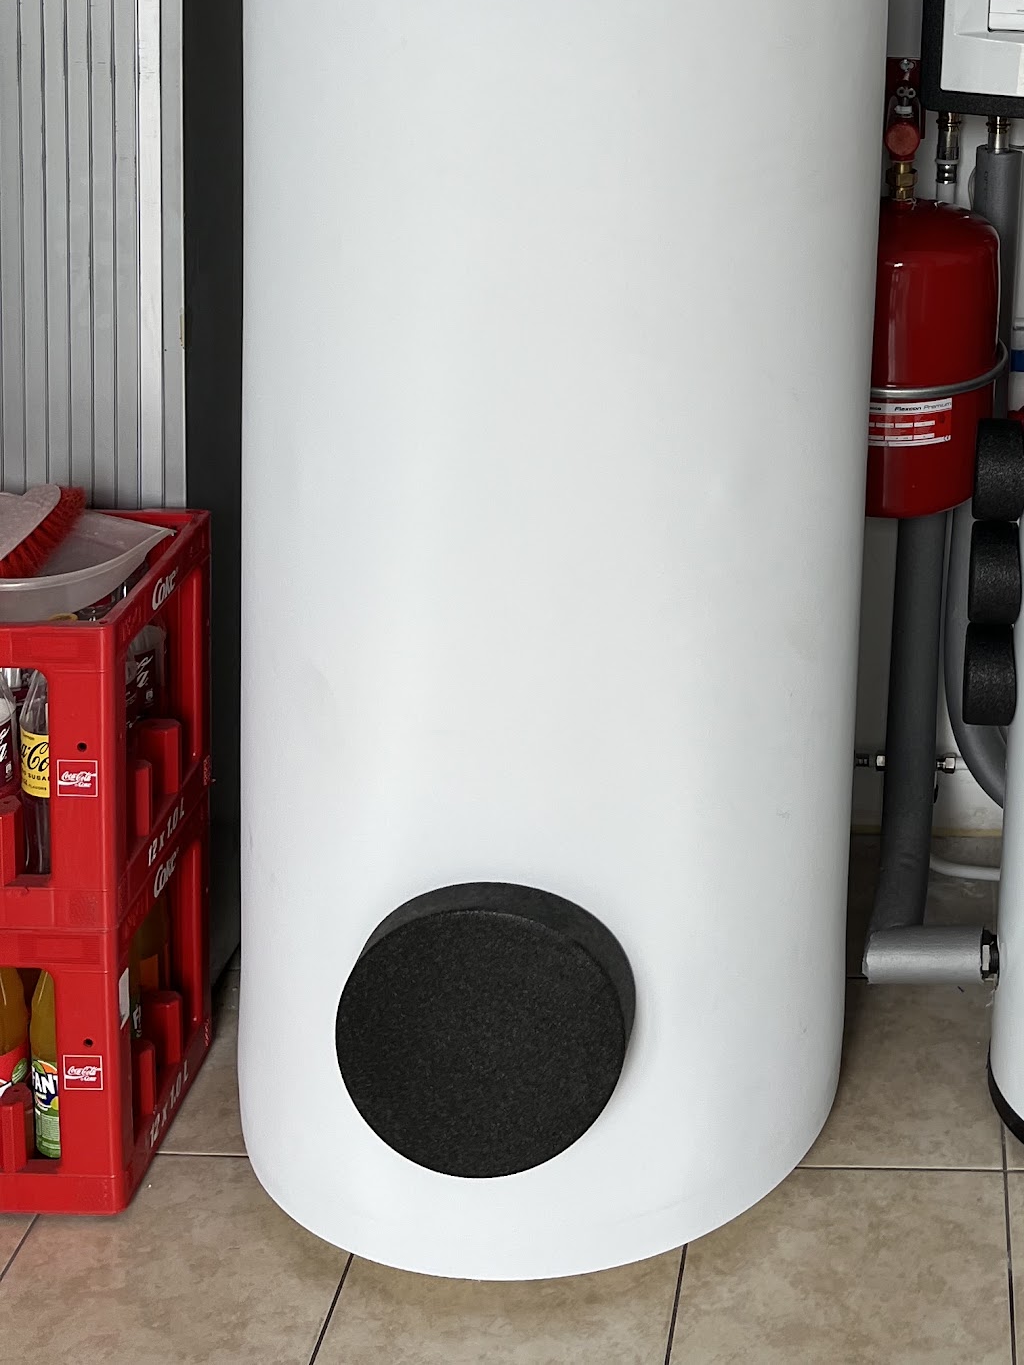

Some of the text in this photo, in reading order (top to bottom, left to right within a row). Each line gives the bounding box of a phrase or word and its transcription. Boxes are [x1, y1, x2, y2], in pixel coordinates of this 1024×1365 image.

[923, 401, 952, 410] Premium
[28, 772, 50, 782] SUGA
[148, 837, 158, 867] 12
